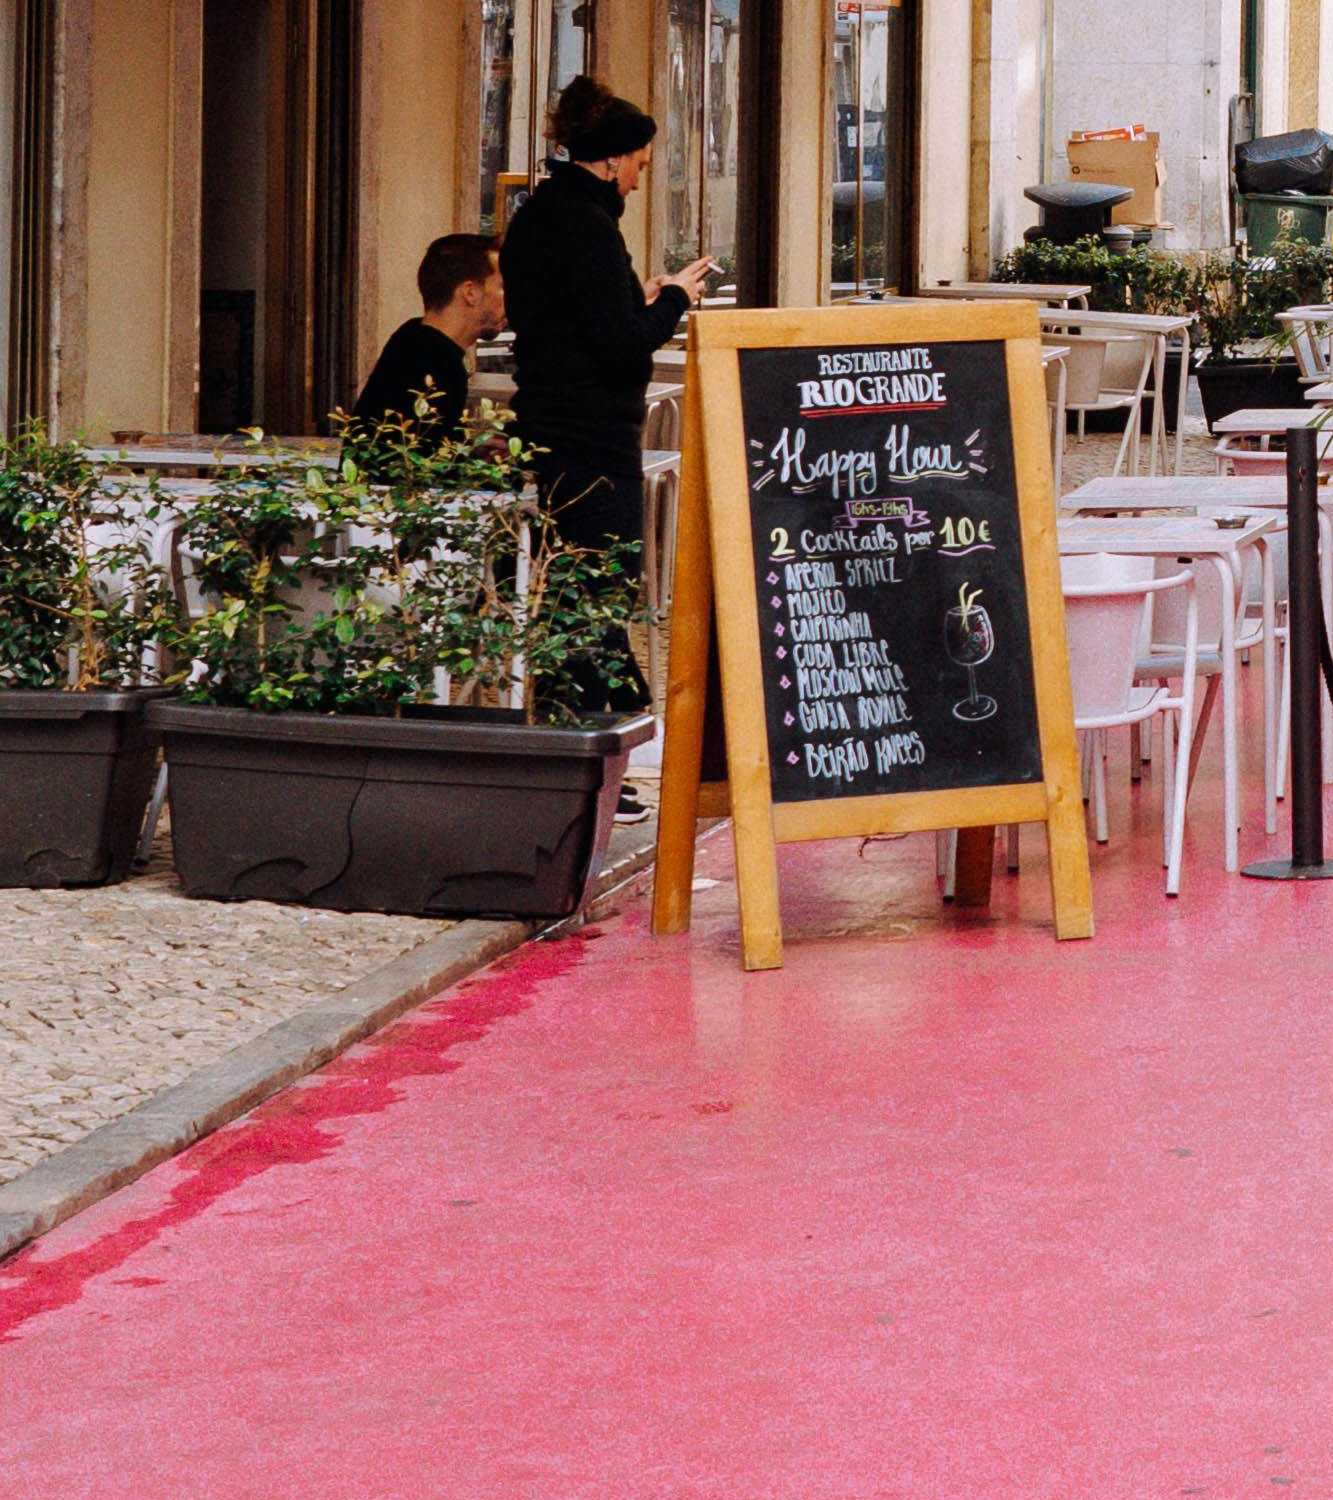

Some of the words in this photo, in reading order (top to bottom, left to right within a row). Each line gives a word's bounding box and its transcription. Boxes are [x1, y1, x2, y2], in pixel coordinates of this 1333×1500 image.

[818, 348, 932, 375] RESTAURANTE
[771, 427, 877, 499] Happy
[885, 424, 963, 475] Hour
[771, 528, 795, 555] 2
[905, 531, 934, 554] por
